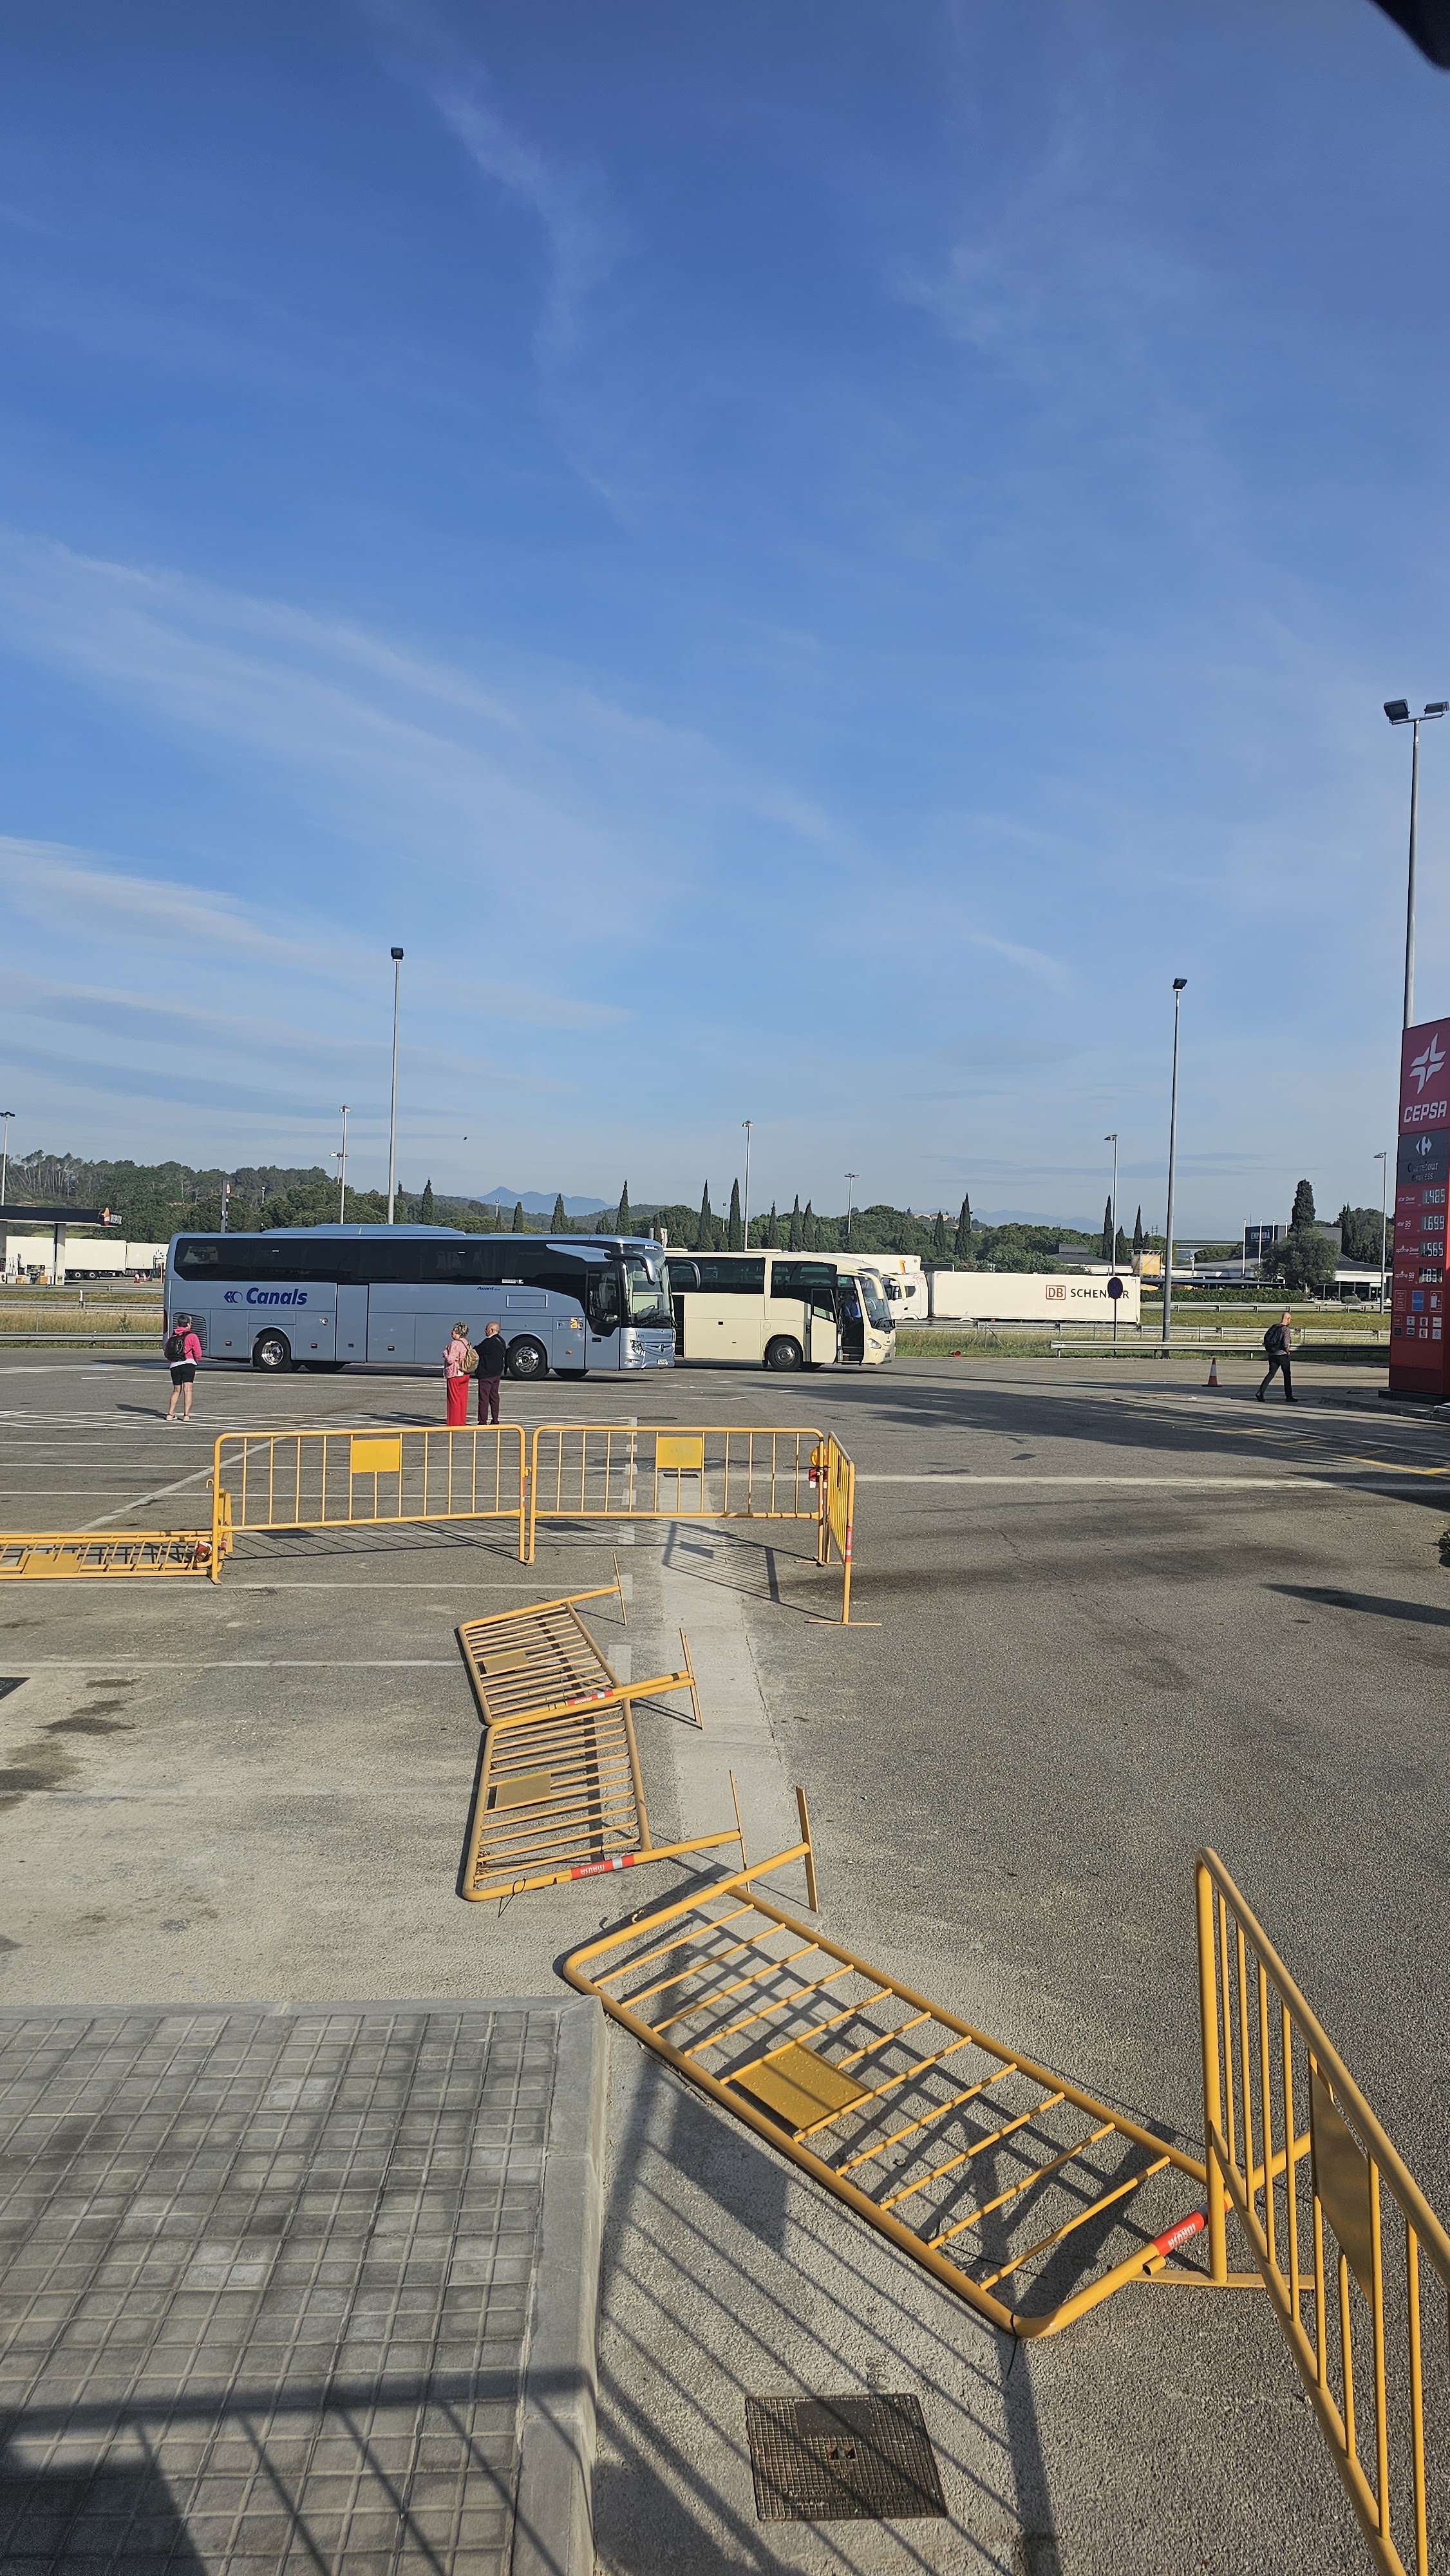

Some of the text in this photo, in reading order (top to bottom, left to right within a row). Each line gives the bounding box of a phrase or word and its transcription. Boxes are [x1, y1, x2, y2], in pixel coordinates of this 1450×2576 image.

[1404, 1101, 1447, 1123] CEPSA
[1424, 1216, 1445, 1231] 1.699
[1423, 1242, 1444, 1256] 1.565
[246, 1287, 308, 1305] Canals
[1048, 1287, 1129, 1299] DB SCHENR
[580, 1864, 605, 1875] MAUSA
[1167, 2223, 1196, 2249] MAUSA
